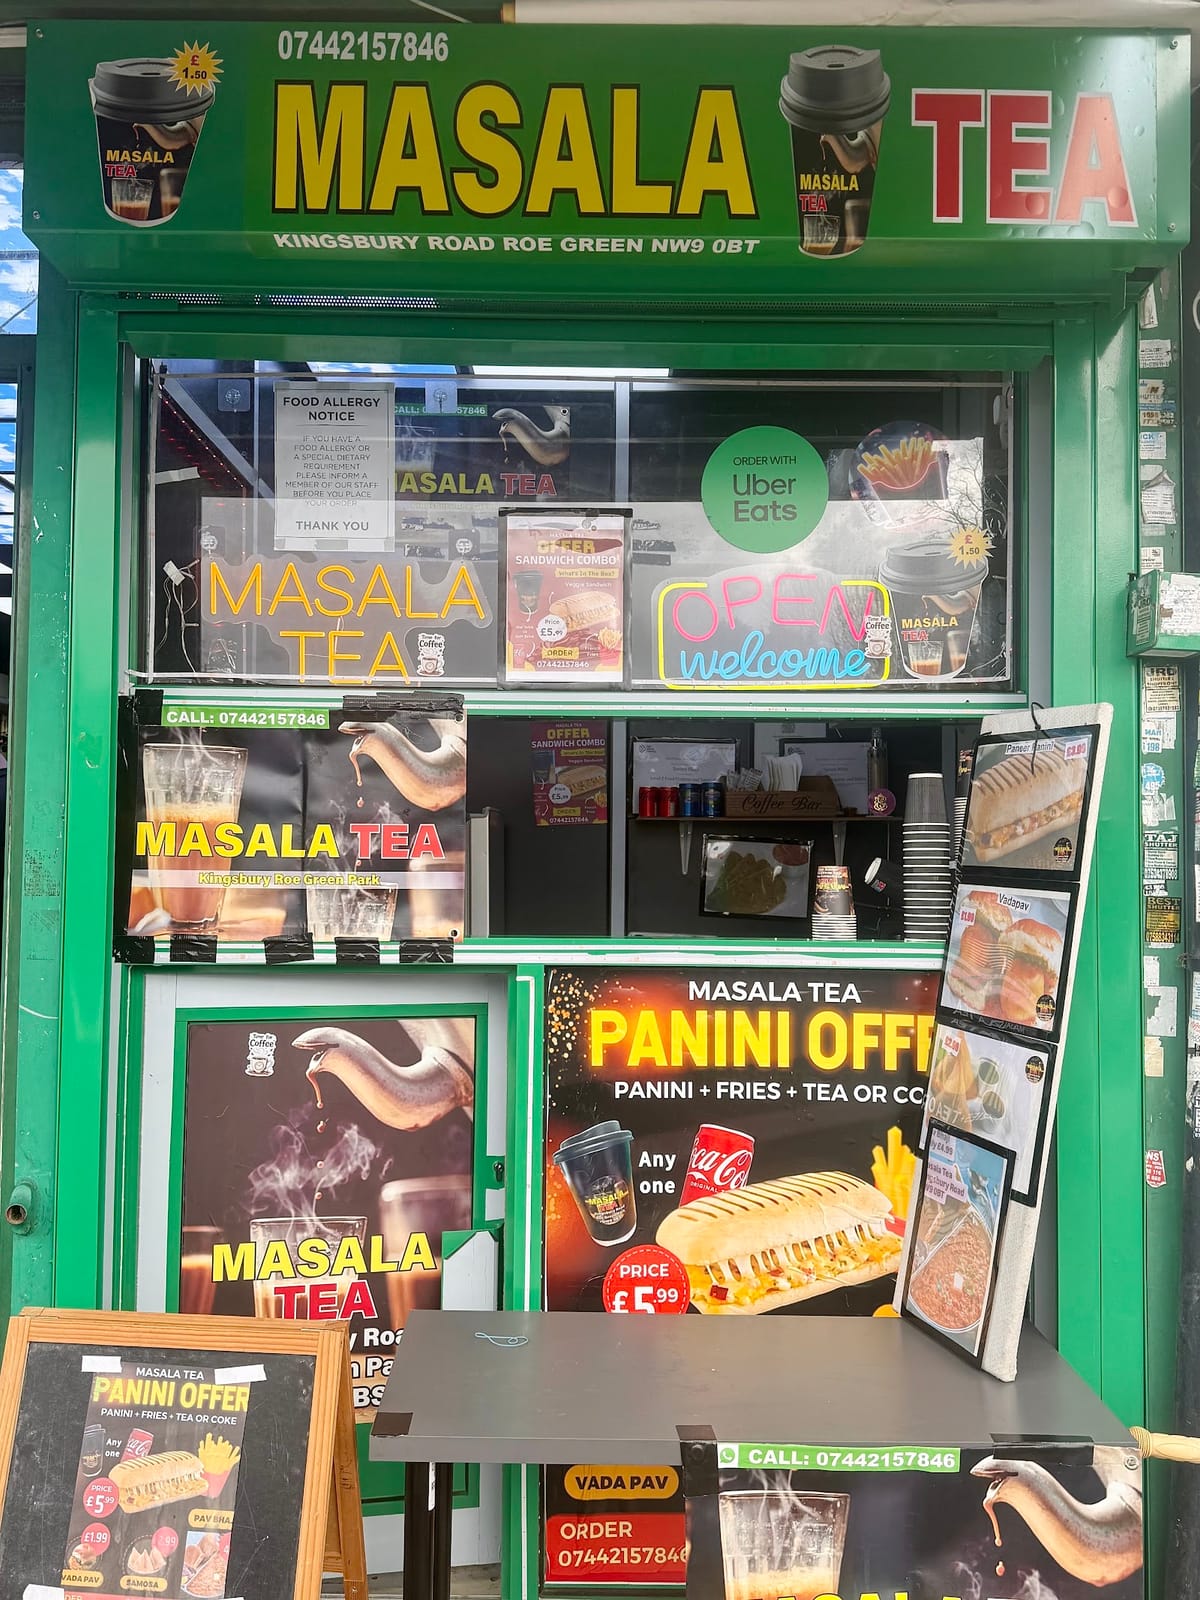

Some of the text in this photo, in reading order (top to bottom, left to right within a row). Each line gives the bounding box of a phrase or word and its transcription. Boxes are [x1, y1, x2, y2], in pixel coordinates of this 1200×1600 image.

[278, 30, 449, 62] 07442157846
[190, 55, 200, 66] £
[182, 67, 207, 80] 1.50
[106, 149, 175, 164] MASALA
[272, 80, 760, 219] MASALA
[911, 88, 1138, 228] TEA
[105, 164, 137, 178] TEA
[800, 173, 859, 192] MASALA
[800, 194, 828, 213] TEA
[273, 233, 419, 251] KINGSBURY
[430, 236, 495, 252] ROAD
[503, 237, 553, 253] ROE
[560, 237, 645, 254] GREEN
[650, 238, 704, 254] NW9
[283, 397, 380, 407] FOOD ALLERGY
[308, 411, 355, 421] NOTICE
[732, 456, 797, 466] ORDER WITH
[500, 473, 558, 496] TEA
[732, 474, 797, 498] Uber
[733, 500, 798, 523] Eats
[296, 521, 369, 531] THANK YOU
[964, 534, 973, 545] £
[958, 545, 980, 556] 1.50
[515, 555, 617, 566] SANDWICH COMBO
[210, 562, 485, 621] MASALA
[673, 573, 876, 643] OPEN
[865, 621, 890, 630] Coffee
[901, 616, 959, 629] MASALA
[901, 631, 929, 641] TEA
[419, 640, 443, 648] Coffee
[279, 630, 411, 686] TEA
[680, 629, 871, 681] welcome
[537, 661, 590, 669] 07442157846
[1146, 667, 1178, 677] JRD
[166, 711, 326, 726] CALL: 07442157846
[547, 728, 590, 739] OFFER
[531, 739, 606, 749] SANDWICH COMBO
[1006, 743, 1030, 753] Paneer
[742, 793, 823, 814] Coffee Bar
[136, 821, 446, 860] MASALA TEA
[1144, 834, 1179, 843] TAJ
[199, 872, 380, 887] Kingsbury Roe Green Park
[999, 893, 1030, 911] Vadapav
[1147, 897, 1181, 906] BEST
[688, 980, 862, 1004] MASALA TEA
[589, 1009, 791, 1068] PANINI
[614, 1081, 925, 1105] PANINI FRIES TEA OR CO
[638, 1150, 677, 1172] Any
[942, 1167, 953, 1179] Tea
[639, 1179, 676, 1194] one
[949, 1183, 965, 1196] Road
[588, 1190, 625, 1206] MASALA
[212, 1232, 437, 1283] MASALA
[619, 1263, 670, 1279] PRICE
[273, 1280, 379, 1321] TEA
[611, 1286, 679, 1315] £5.99
[363, 1327, 405, 1348] Roa
[136, 1367, 205, 1381] MASALA TEA
[366, 1356, 395, 1379] Pa
[92, 1376, 250, 1413] PANINI OFFER
[101, 1408, 237, 1425] PANINI FRIES TEA OR COKE
[105, 1437, 122, 1448] Any
[105, 1449, 121, 1458] one
[748, 1448, 957, 1469] CALL: 07442157846
[91, 1484, 113, 1493] PRICE
[575, 1474, 669, 1491] VADA PAV
[194, 1514, 213, 1523] PAV
[83, 1531, 108, 1544] £1.99
[560, 1521, 634, 1541] ORDER
[62, 1574, 100, 1584] VADA PAV
[126, 1579, 160, 1589] SAMOSA
